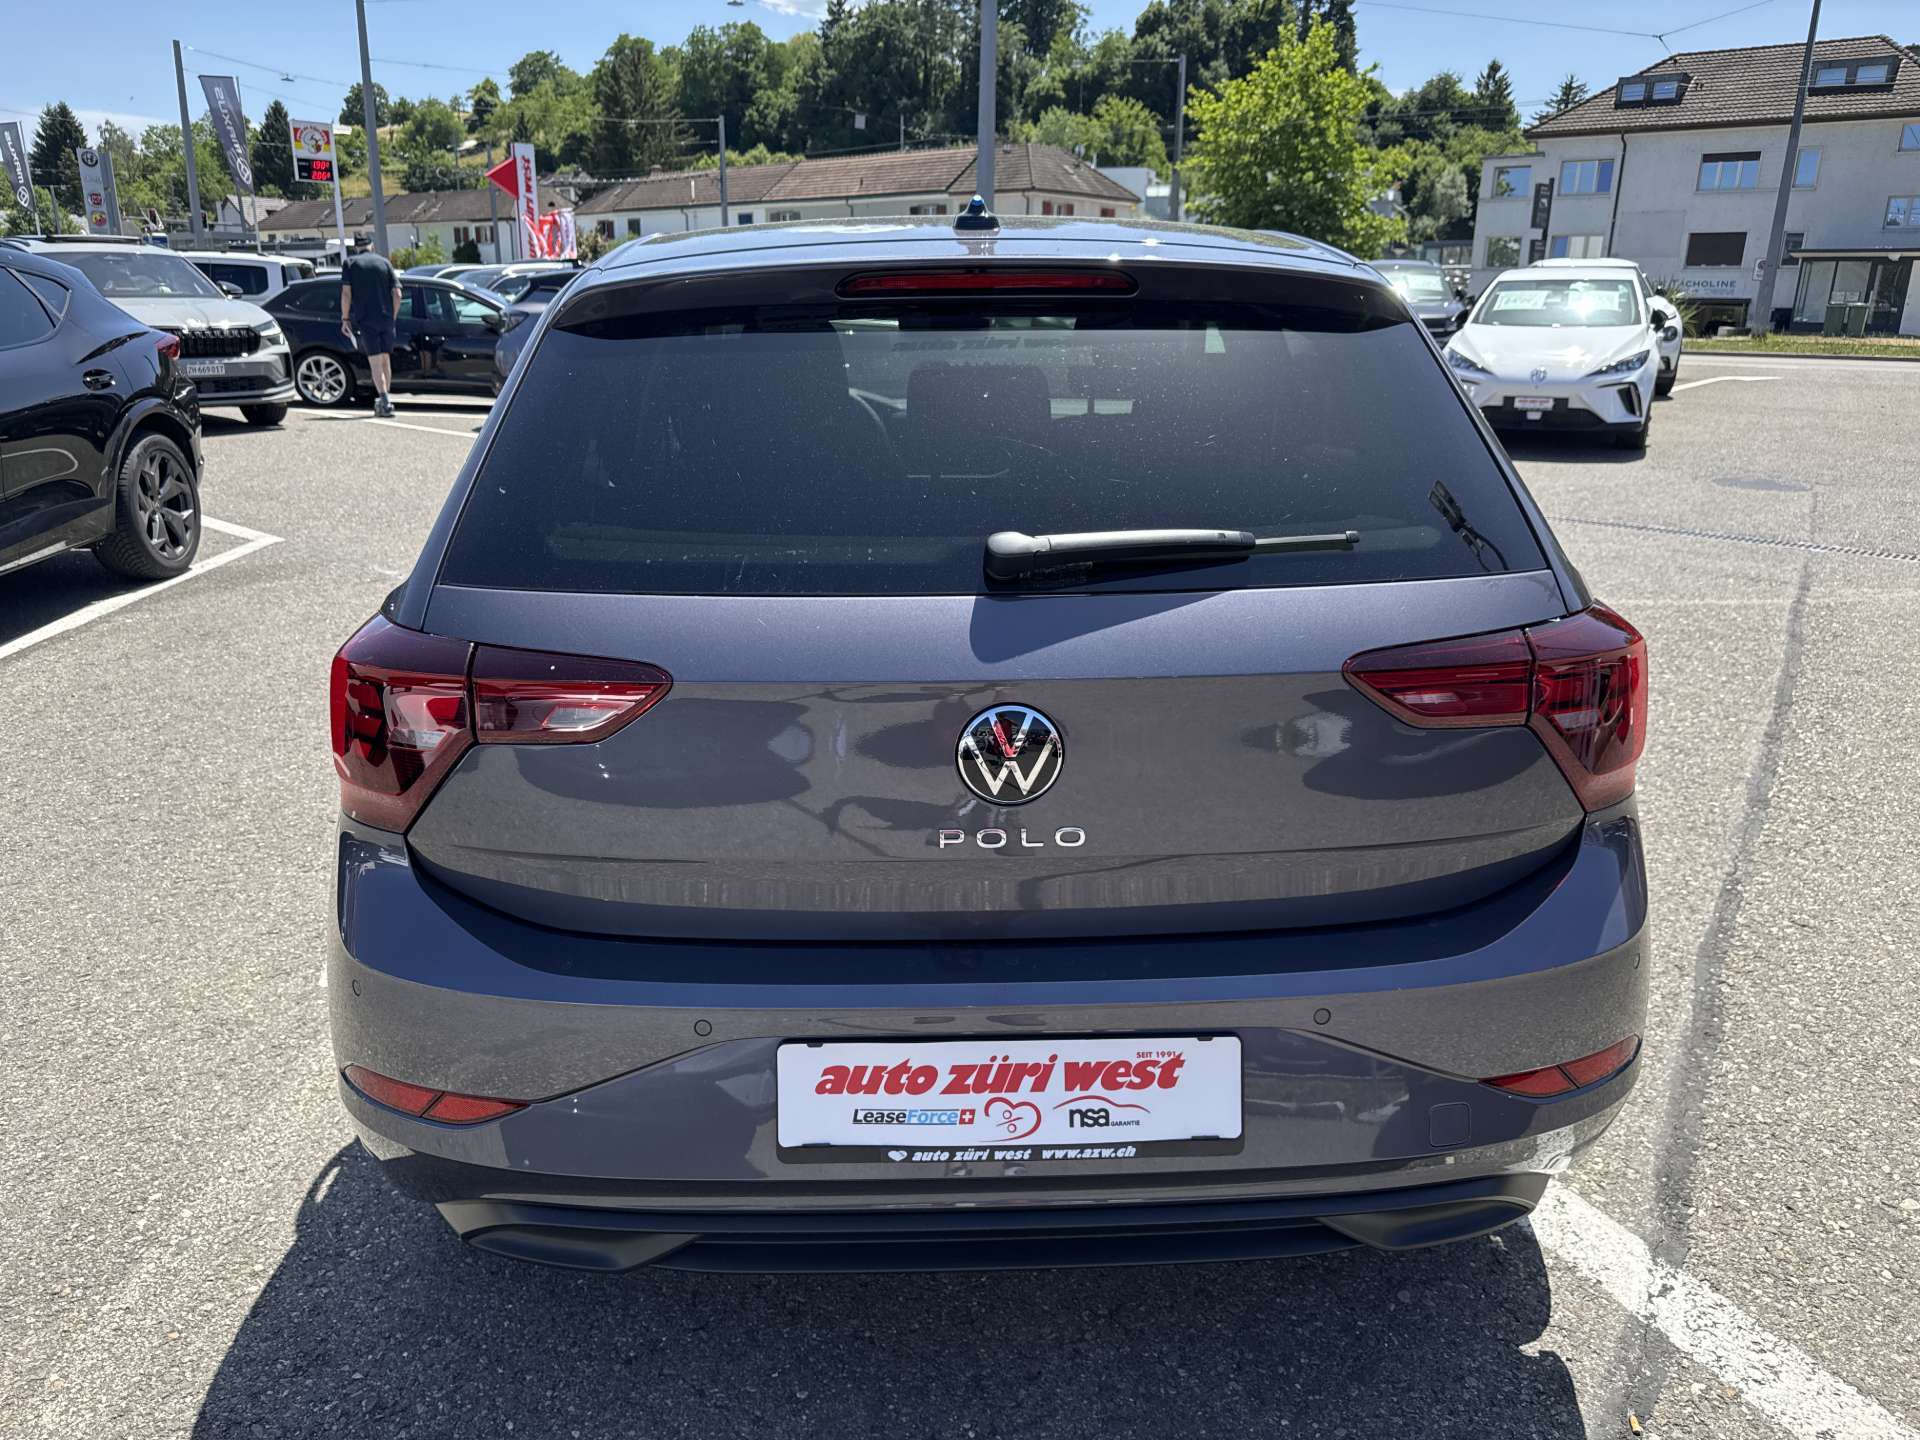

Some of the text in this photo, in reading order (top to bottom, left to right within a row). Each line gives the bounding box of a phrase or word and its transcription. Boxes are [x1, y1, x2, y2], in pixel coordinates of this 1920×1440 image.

[939, 827, 1086, 849] POLO
[1136, 1051, 1153, 1059] SEIT
[815, 1052, 1185, 1095] auto züri west
[853, 1108, 958, 1125] LeaseForce
[1069, 1107, 1140, 1128] nsa GARANTIE
[912, 1146, 1137, 1162] auto züri west www.azw.ch
